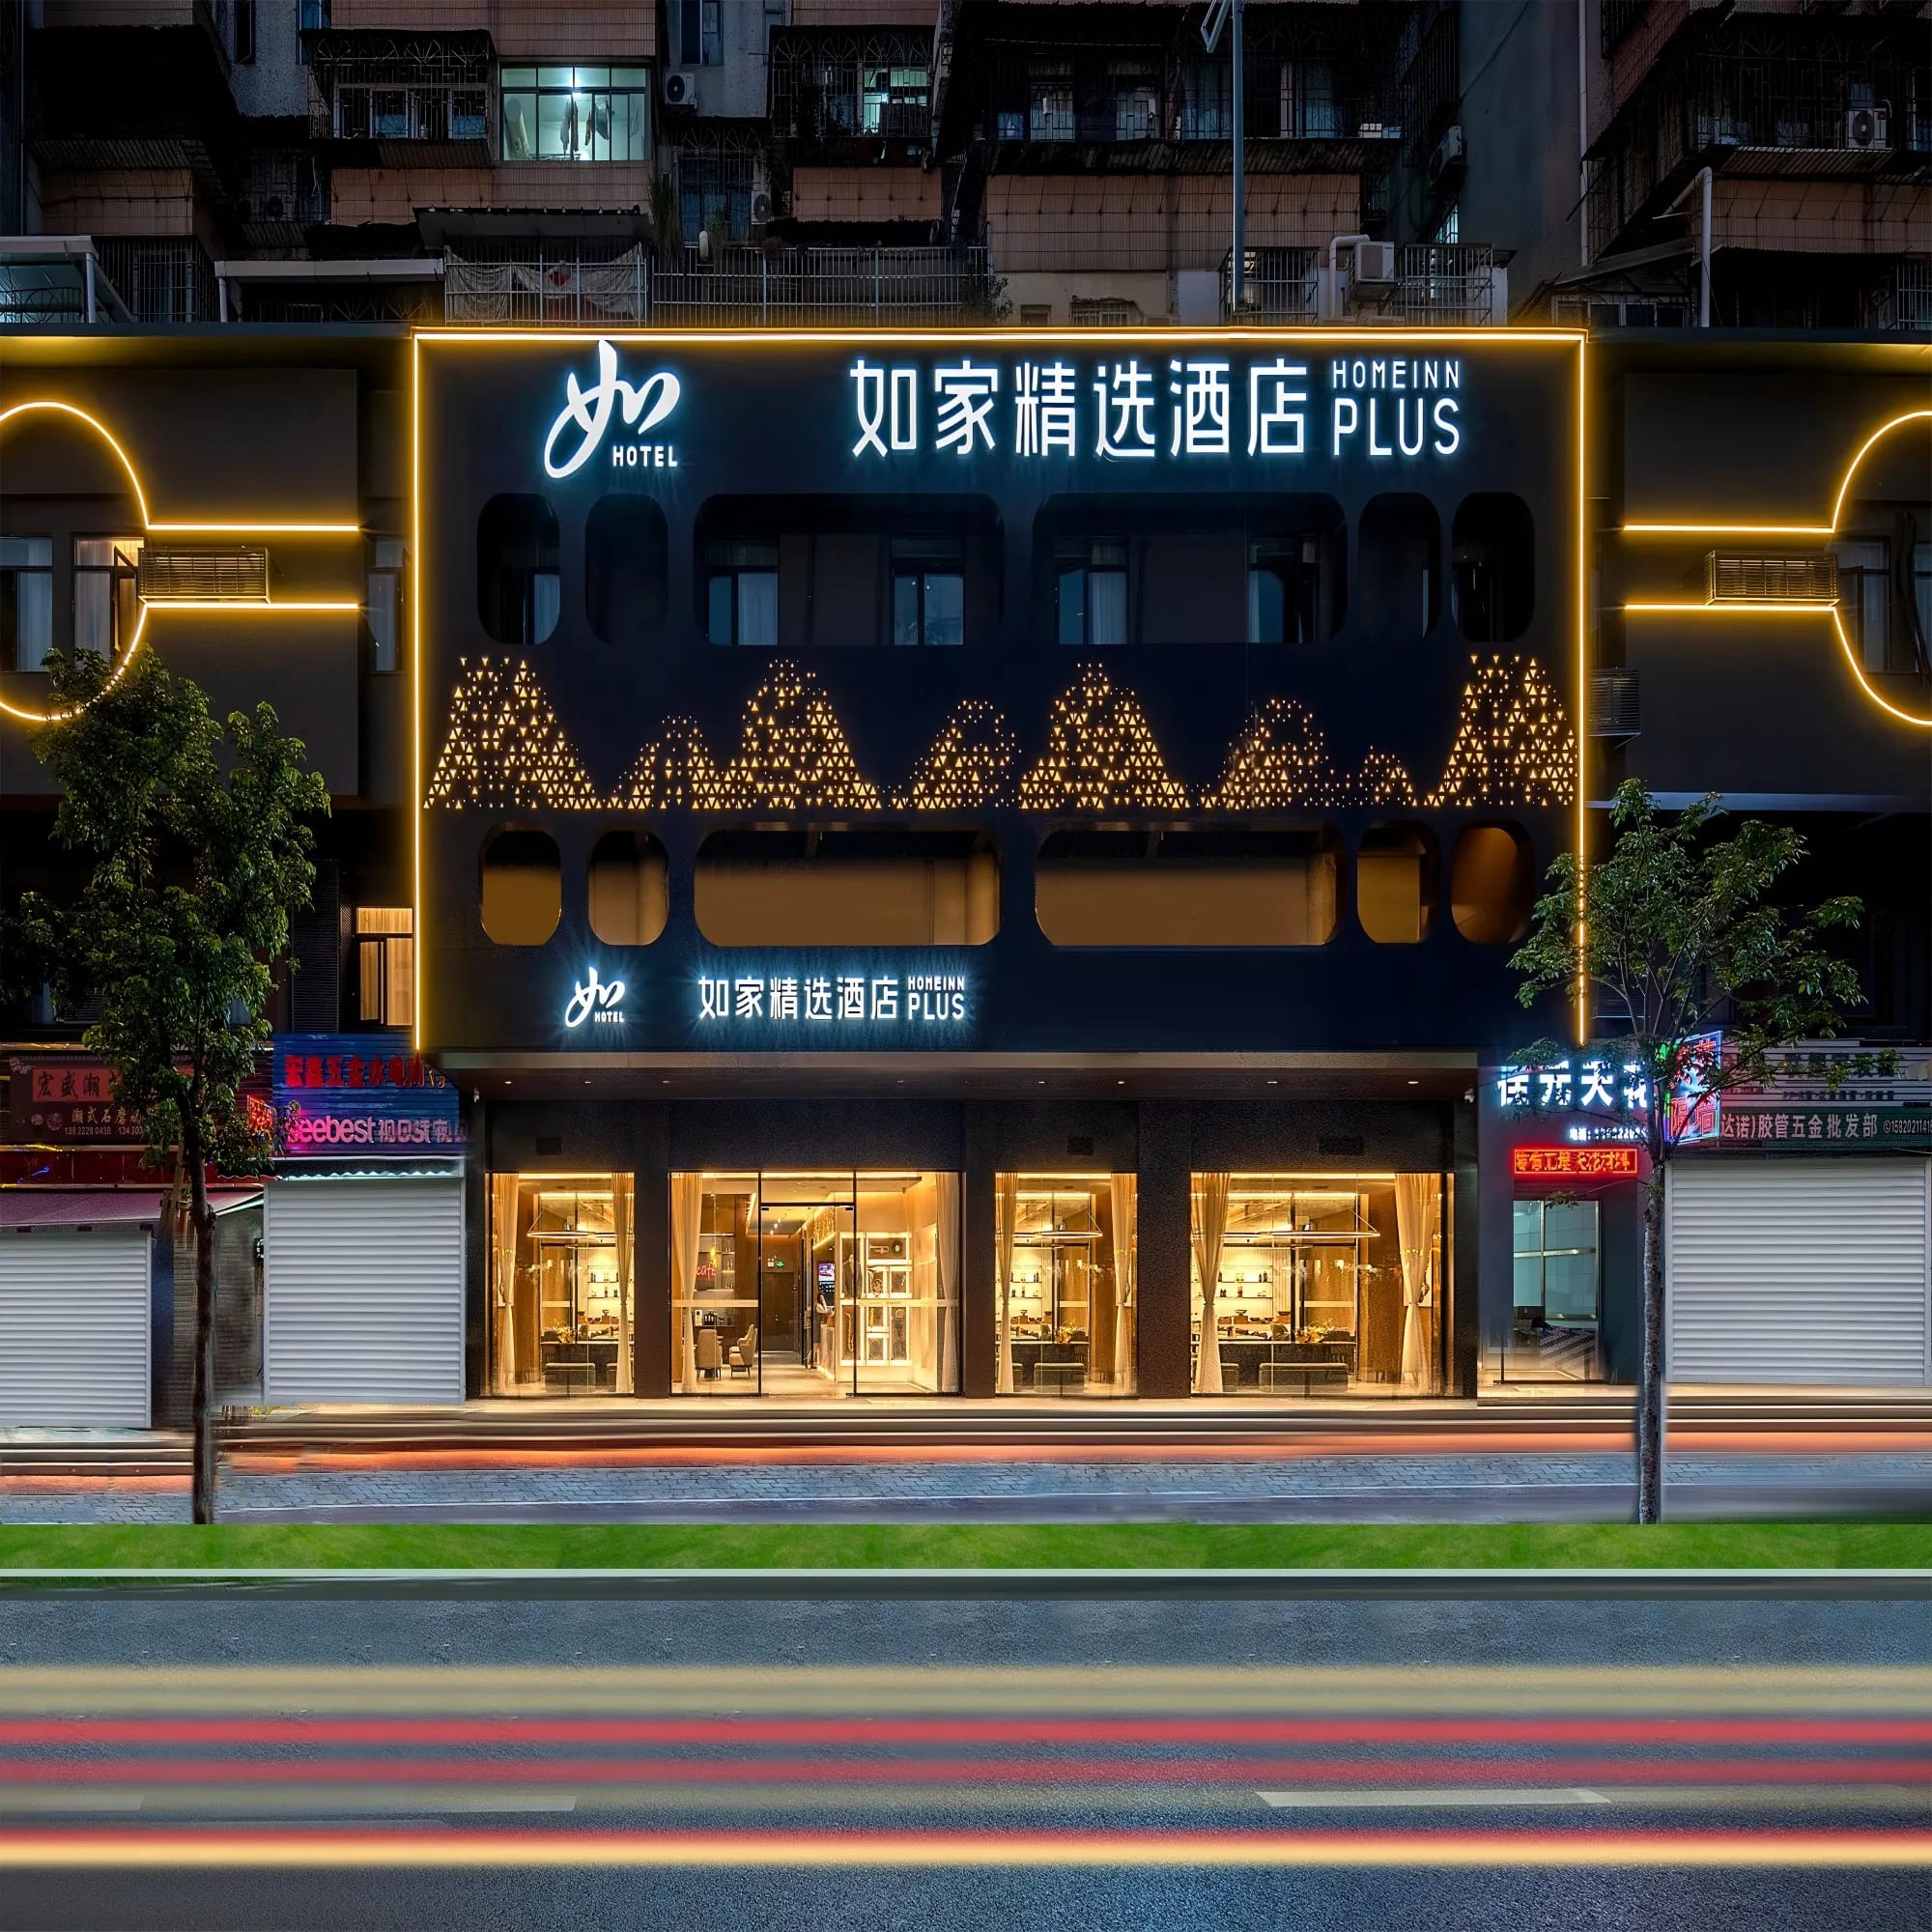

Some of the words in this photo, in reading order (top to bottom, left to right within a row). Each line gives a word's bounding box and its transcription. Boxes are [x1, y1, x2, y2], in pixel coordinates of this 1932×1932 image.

[1332, 360, 1460, 389] HOMEINN
[850, 358, 1307, 462] 如家精选酒店
[1333, 397, 1460, 457] PLUS
[612, 445, 678, 468] HOTEL
[697, 975, 898, 1020] 如家精选酒店
[907, 975, 965, 991] HOMEINN
[594, 1010, 625, 1023] HOTEL
[908, 992, 965, 1021] PLUS
[286, 1116, 376, 1144] eebest
